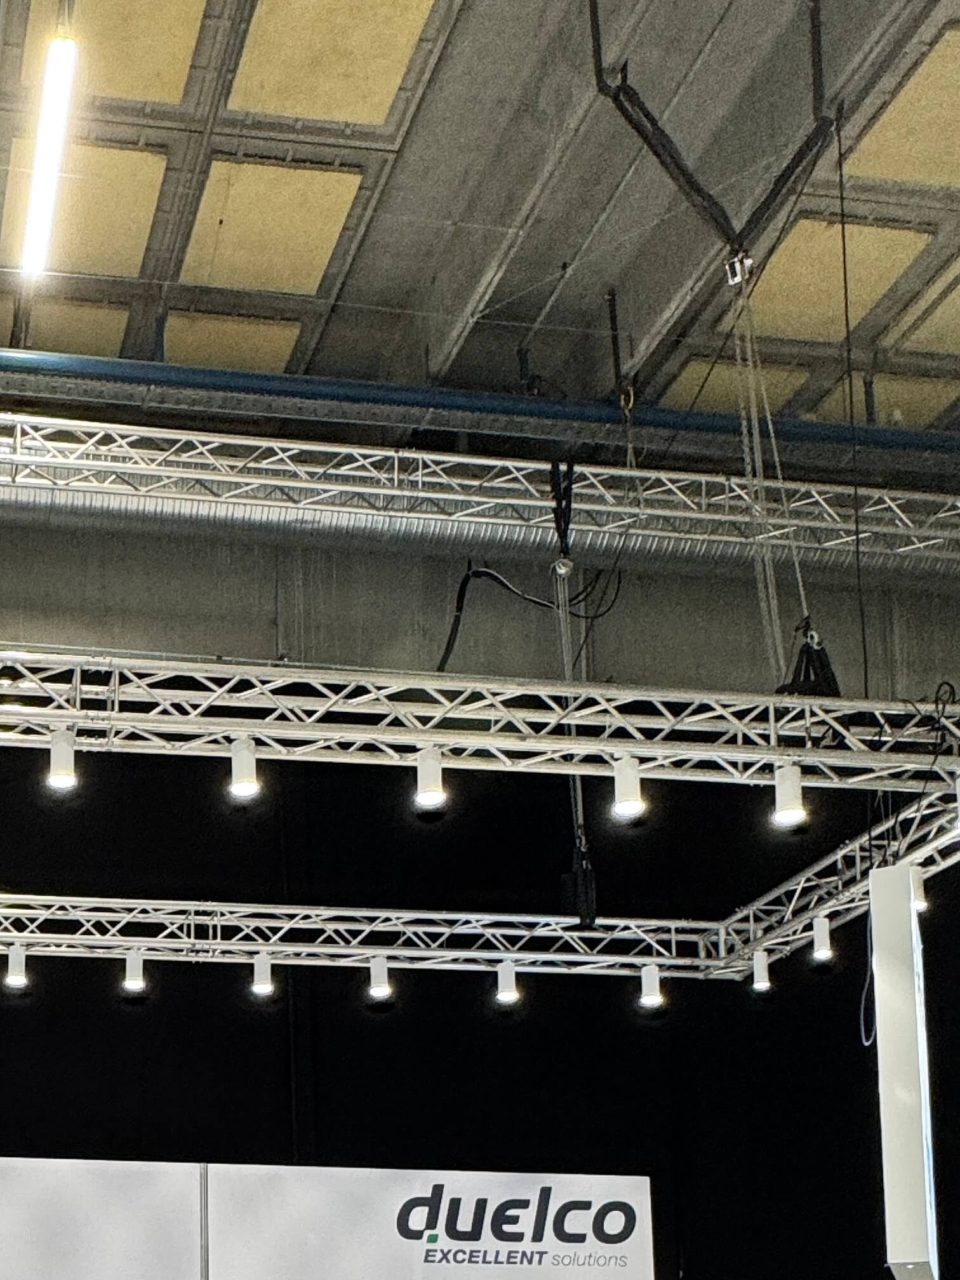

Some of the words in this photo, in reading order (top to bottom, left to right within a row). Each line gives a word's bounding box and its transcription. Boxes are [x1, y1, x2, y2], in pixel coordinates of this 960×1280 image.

[396, 1183, 637, 1245] duelco
[423, 1248, 548, 1266] EXCELLENT
[550, 1251, 628, 1268] solutions
